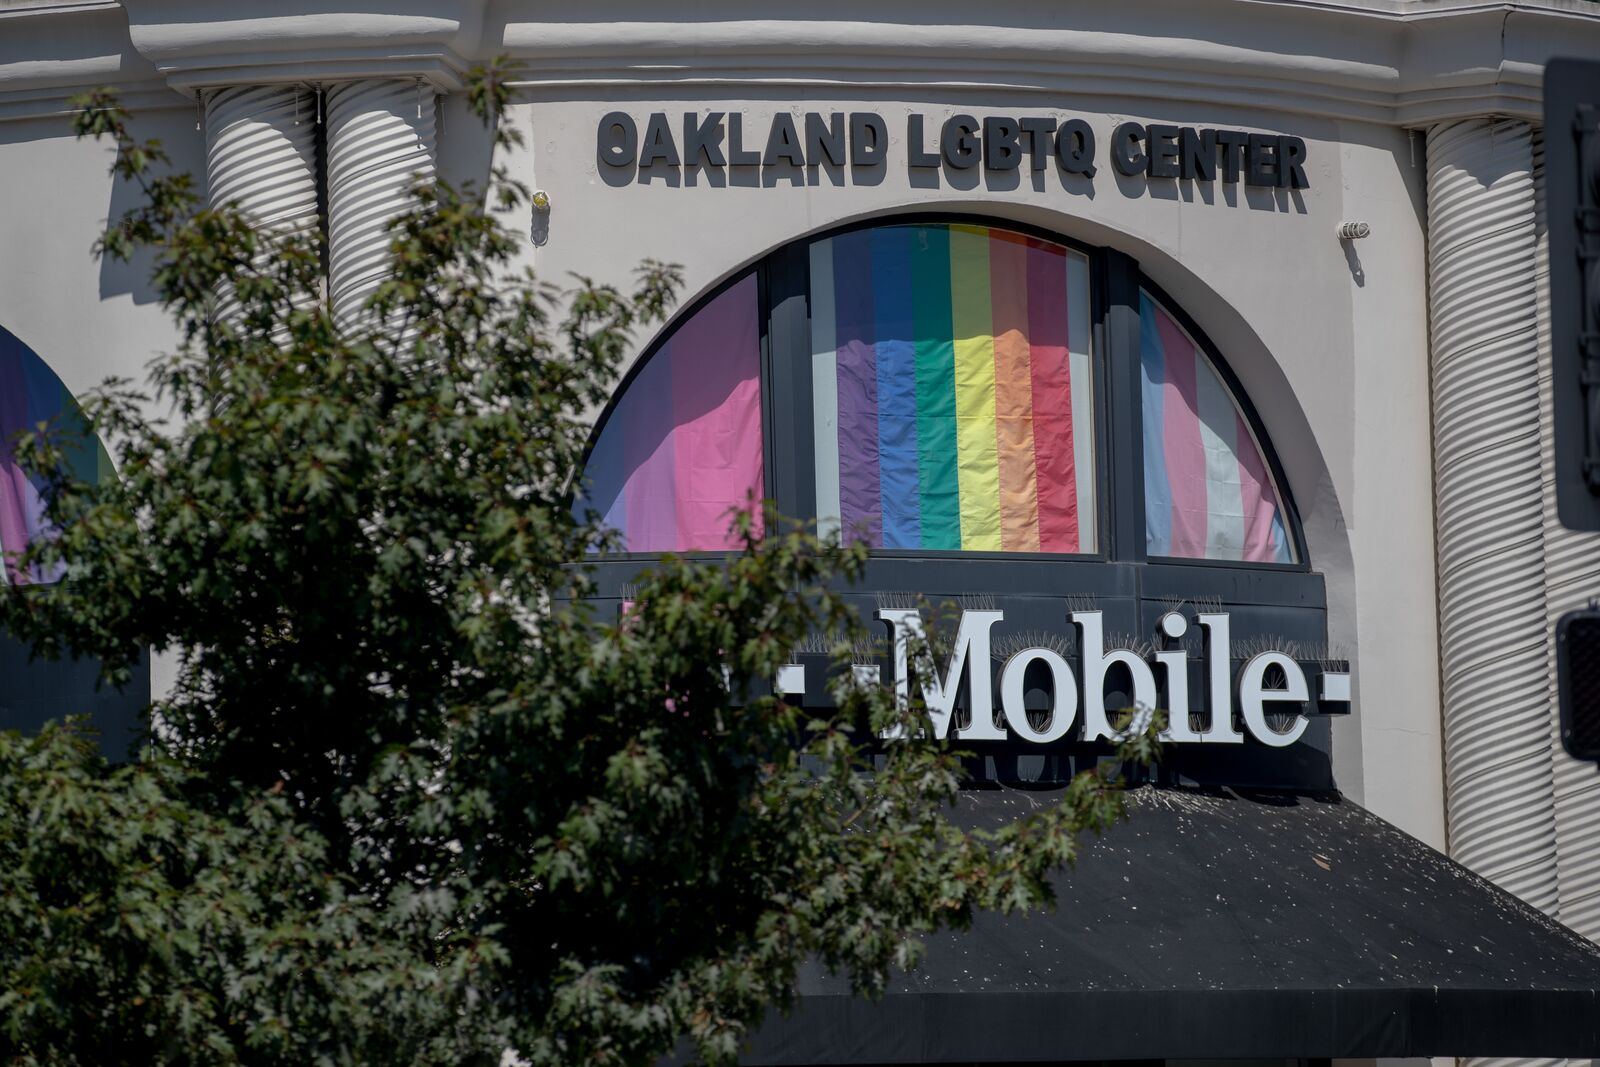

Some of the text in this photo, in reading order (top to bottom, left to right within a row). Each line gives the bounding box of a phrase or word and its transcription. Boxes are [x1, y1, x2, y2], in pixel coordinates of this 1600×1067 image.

[598, 111, 1310, 190] OAKLAND LGBTQ CENTER
